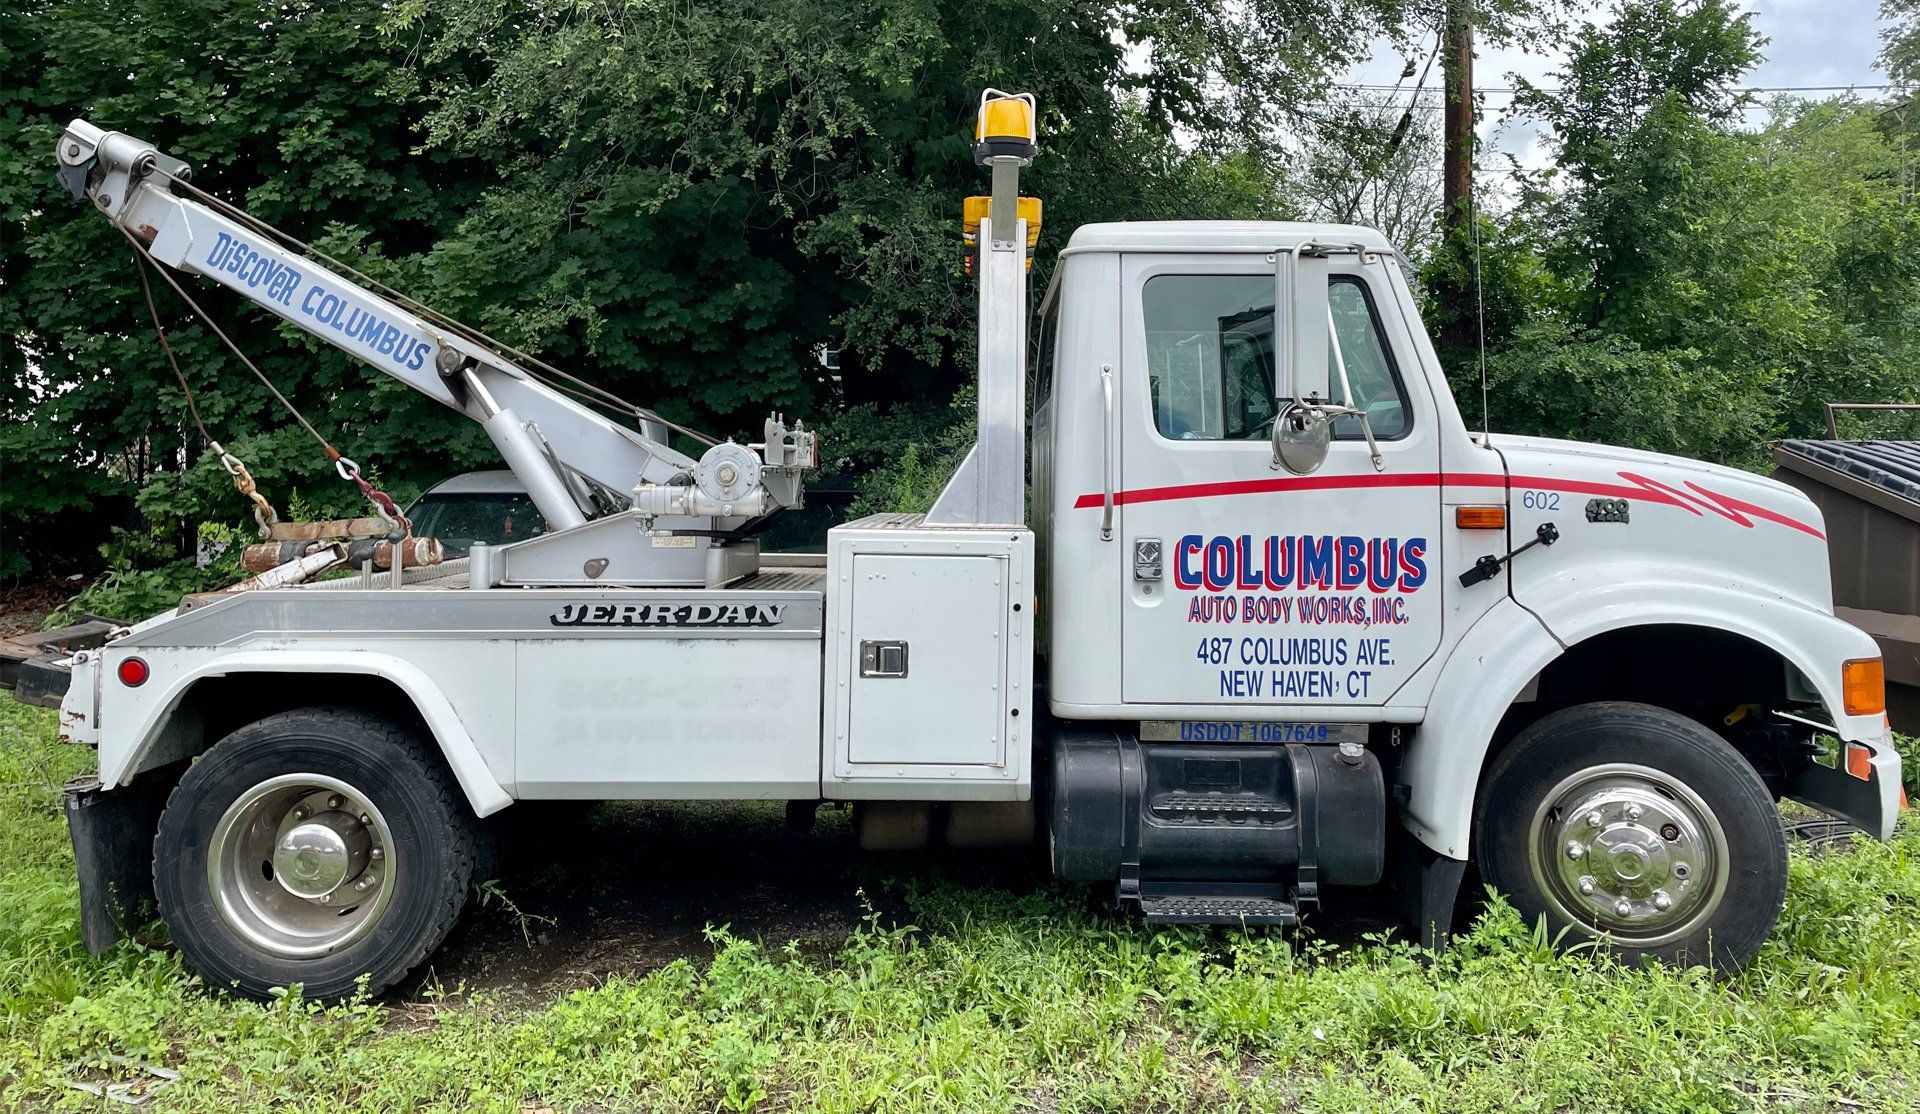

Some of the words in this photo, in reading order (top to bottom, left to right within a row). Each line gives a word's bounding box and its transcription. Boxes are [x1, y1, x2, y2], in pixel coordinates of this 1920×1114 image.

[301, 285, 431, 371] COLUMBUS
[1523, 491, 1560, 511] 602
[1585, 498, 1629, 513] 4700
[1173, 535, 1427, 593] COLUMBUS
[550, 604, 788, 627] JERR-DAN
[1188, 595, 1237, 623] AUTO
[1242, 595, 1293, 625] BODY
[1197, 637, 1232, 665] 487
[1240, 637, 1348, 666] COLUMBUS
[1356, 638, 1395, 665] AVE.
[1220, 670, 1263, 697] NEW
[1272, 670, 1340, 698] HAVEN,
[1346, 670, 1371, 698] CT
[1180, 722, 1243, 741] USDOT
[1251, 723, 1328, 742] 1067649
